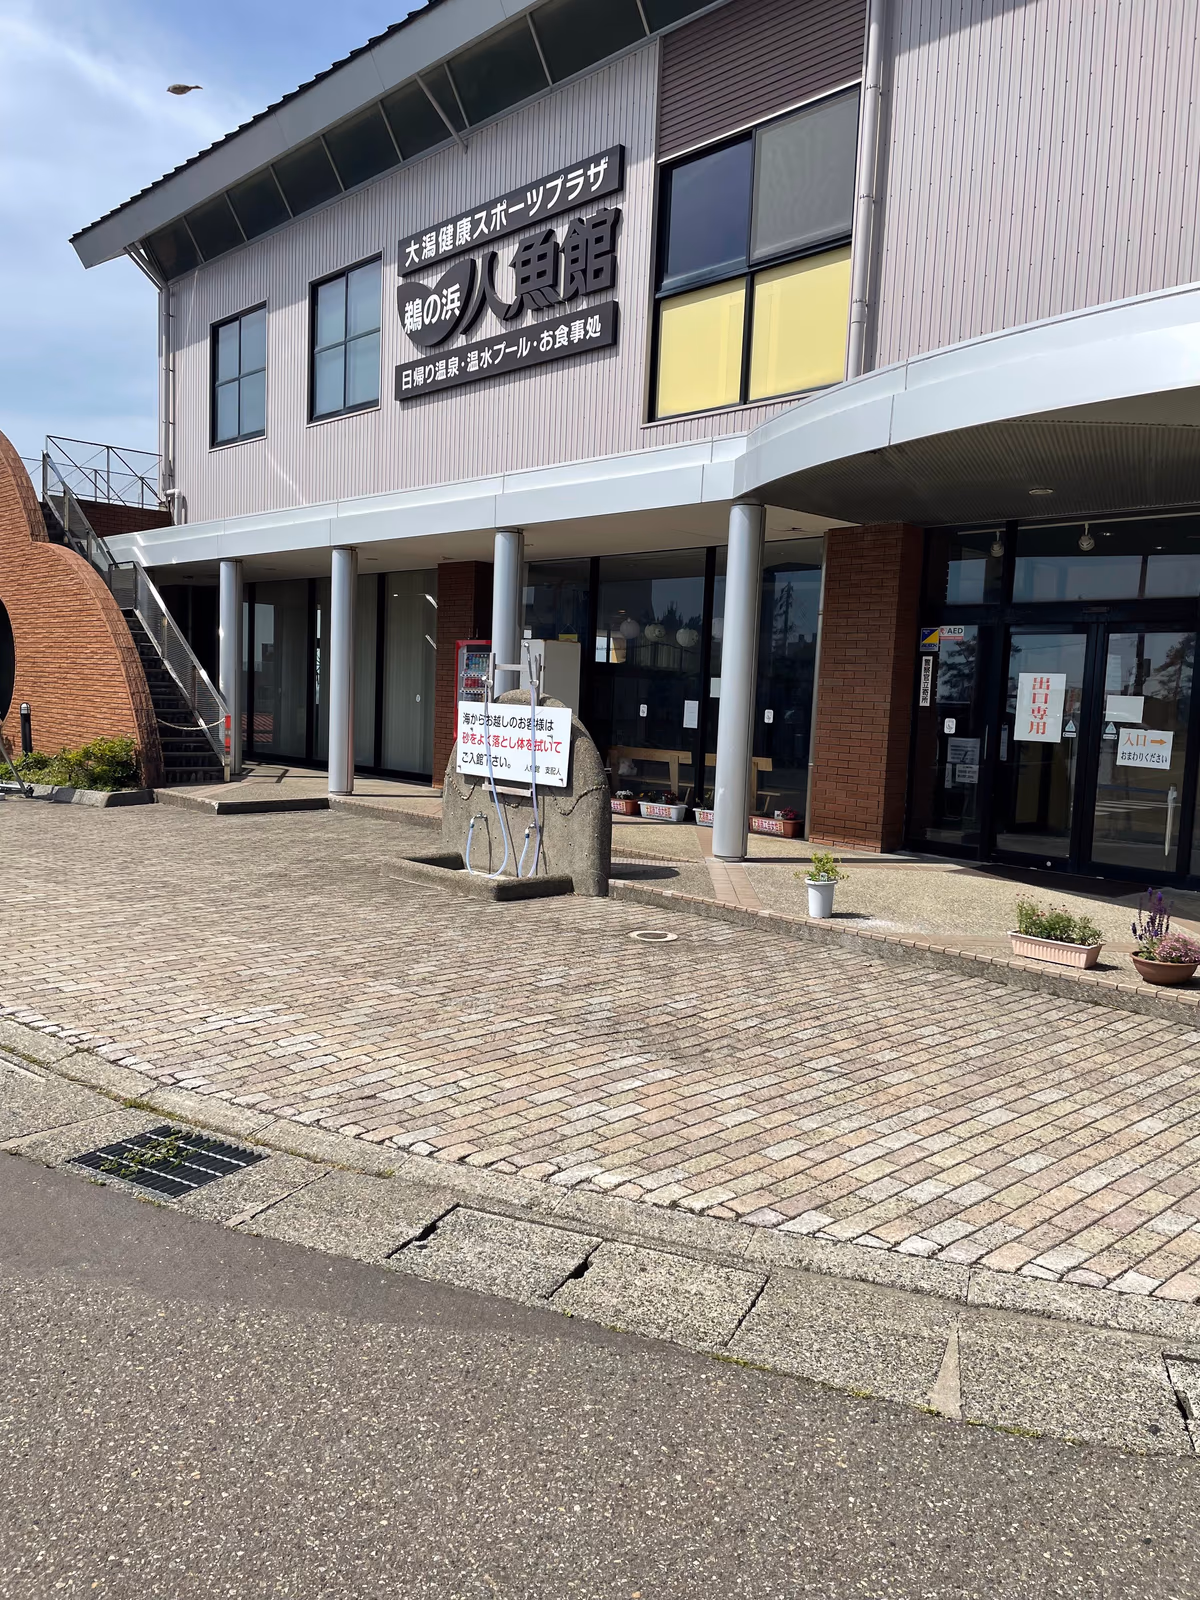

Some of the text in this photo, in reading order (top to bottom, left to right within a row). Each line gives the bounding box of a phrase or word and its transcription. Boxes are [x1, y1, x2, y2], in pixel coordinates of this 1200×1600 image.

[405, 156, 609, 268] 大潟健康スポーツプラザ
[460, 206, 622, 335] 人魚館
[404, 282, 461, 334] 鵜の浜
[401, 314, 602, 391] 日帰り温泉・温水プール・お食事処
[947, 627, 964, 635] AED
[1028, 677, 1050, 735] 出口専用
[462, 712, 554, 731] 海からお越しのお客様は
[462, 732, 562, 754] 砂をよく落とし体を拭いて
[1123, 732, 1148, 747] 入口
[1120, 751, 1168, 764] おまわりください
[544, 766, 562, 776] 支配人
